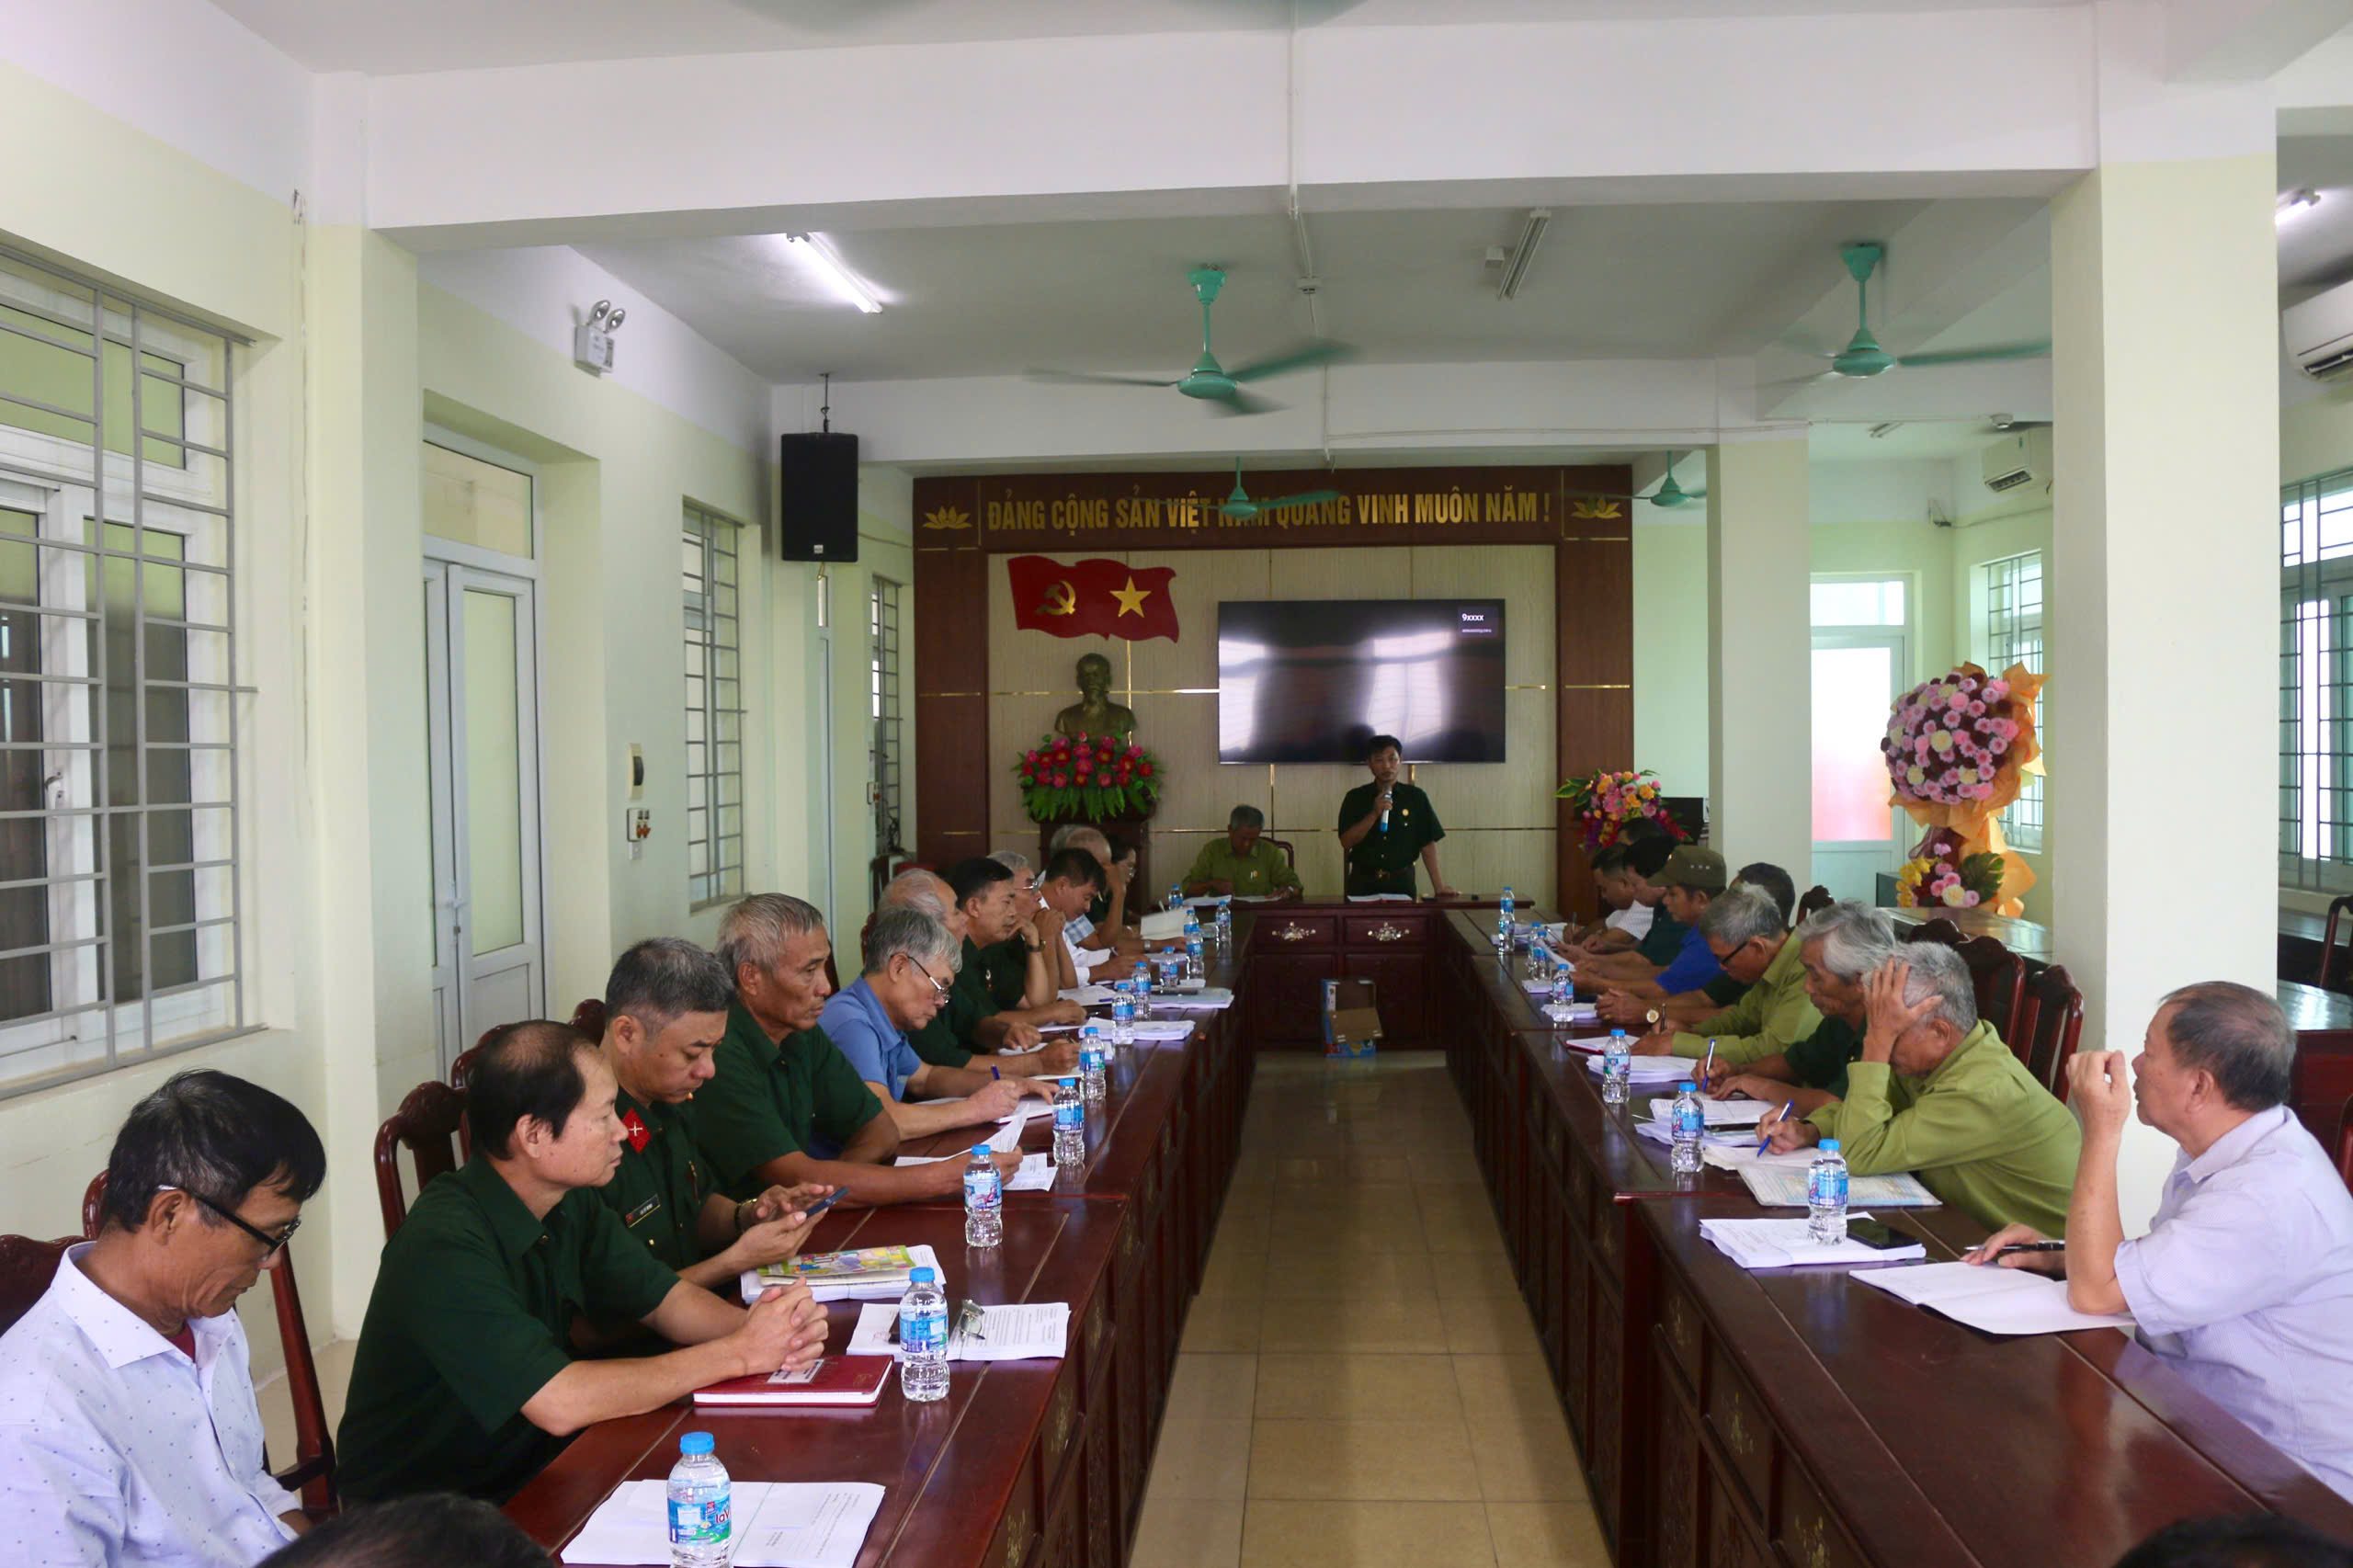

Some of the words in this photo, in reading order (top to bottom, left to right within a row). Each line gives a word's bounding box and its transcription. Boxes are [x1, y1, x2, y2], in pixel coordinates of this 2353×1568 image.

[987, 488, 1045, 530] ĐẢNG
[1051, 493, 1108, 537] CỘNG
[1116, 484, 1160, 528] SẢN
[1166, 490, 1211, 534] VIỆT
[1277, 495, 1350, 529] QUANG
[1357, 494, 1408, 524] VINH
[1415, 485, 1479, 523] MUÔN
[1485, 484, 1537, 523] NĂM
